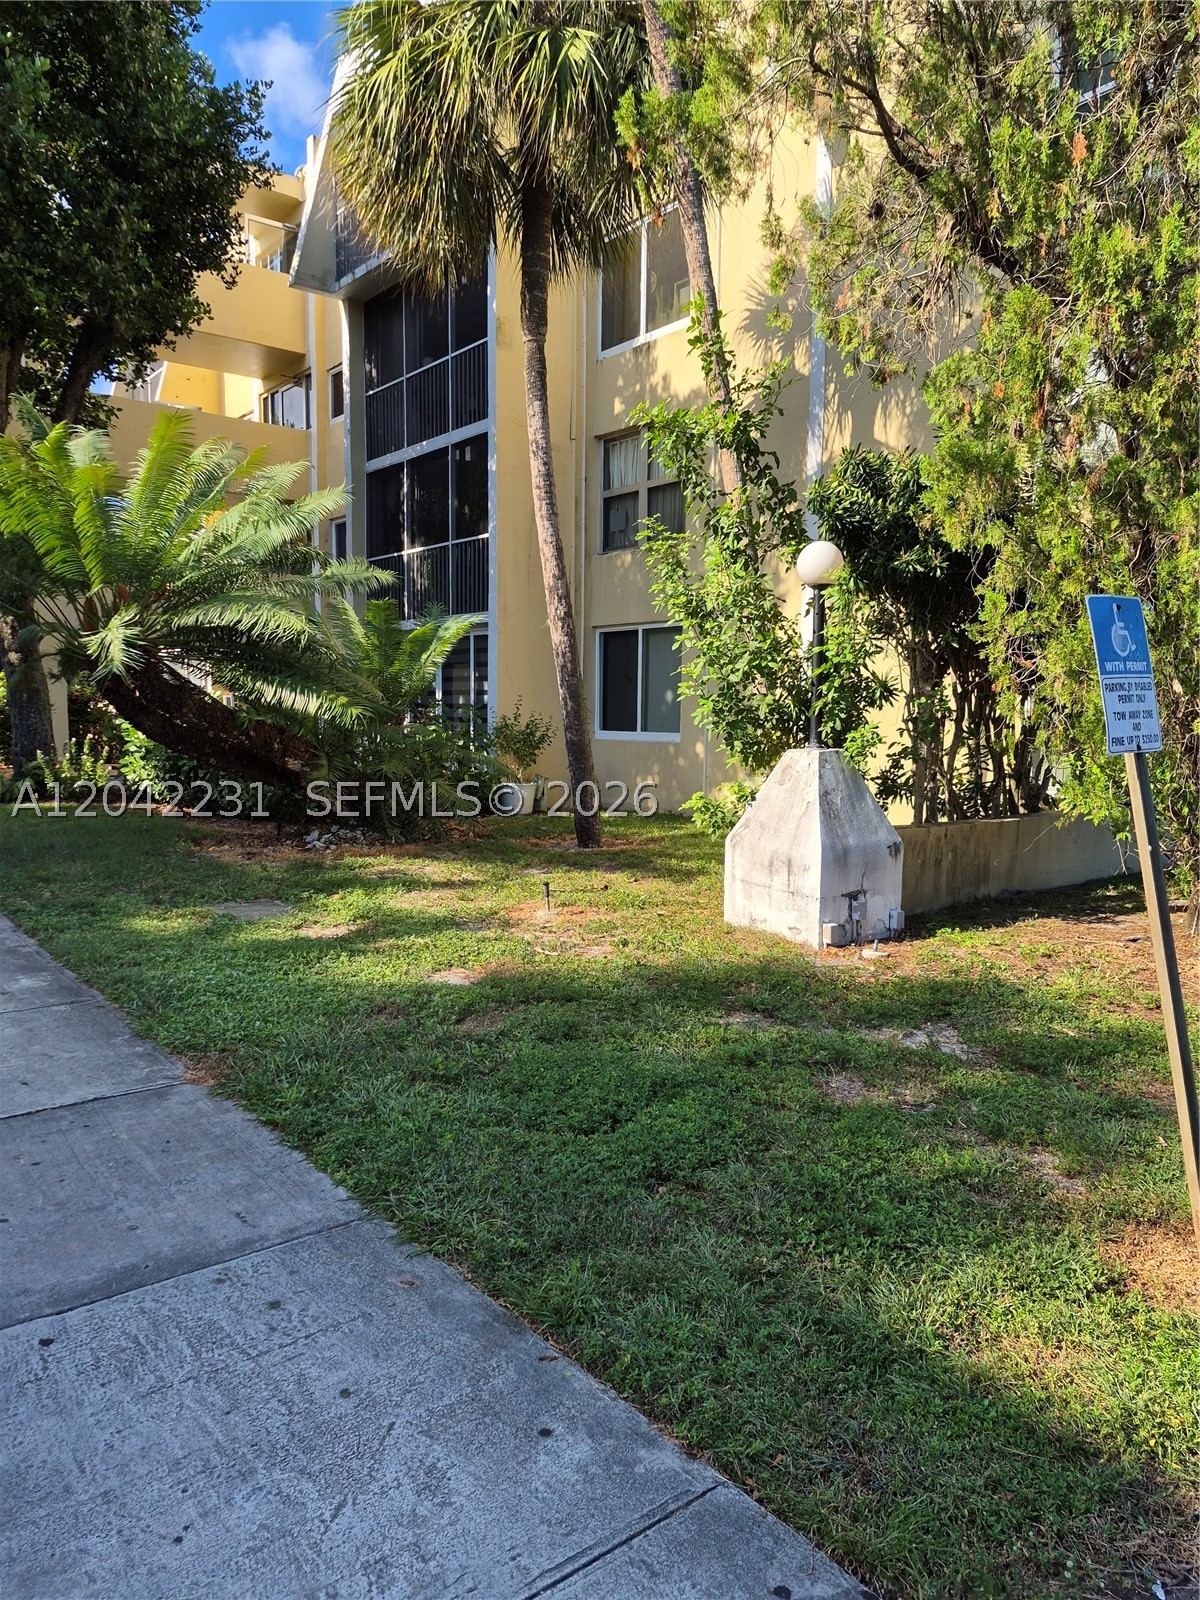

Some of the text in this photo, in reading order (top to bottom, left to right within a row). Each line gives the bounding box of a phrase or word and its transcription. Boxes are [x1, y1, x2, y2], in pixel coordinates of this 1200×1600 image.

[1104, 661, 1147, 671] WITH PERMIT
[1105, 682, 1128, 692] PARKING
[1135, 682, 1152, 690] DISABLED
[1118, 694, 1145, 704] PERMIT ONLY
[1113, 710, 1153, 721] TOW AWAY ZONE
[1133, 722, 1141, 731] AND
[1111, 737, 1124, 747] FINE
[1127, 736, 1134, 745] UP
[1134, 735, 1140, 744] TO
